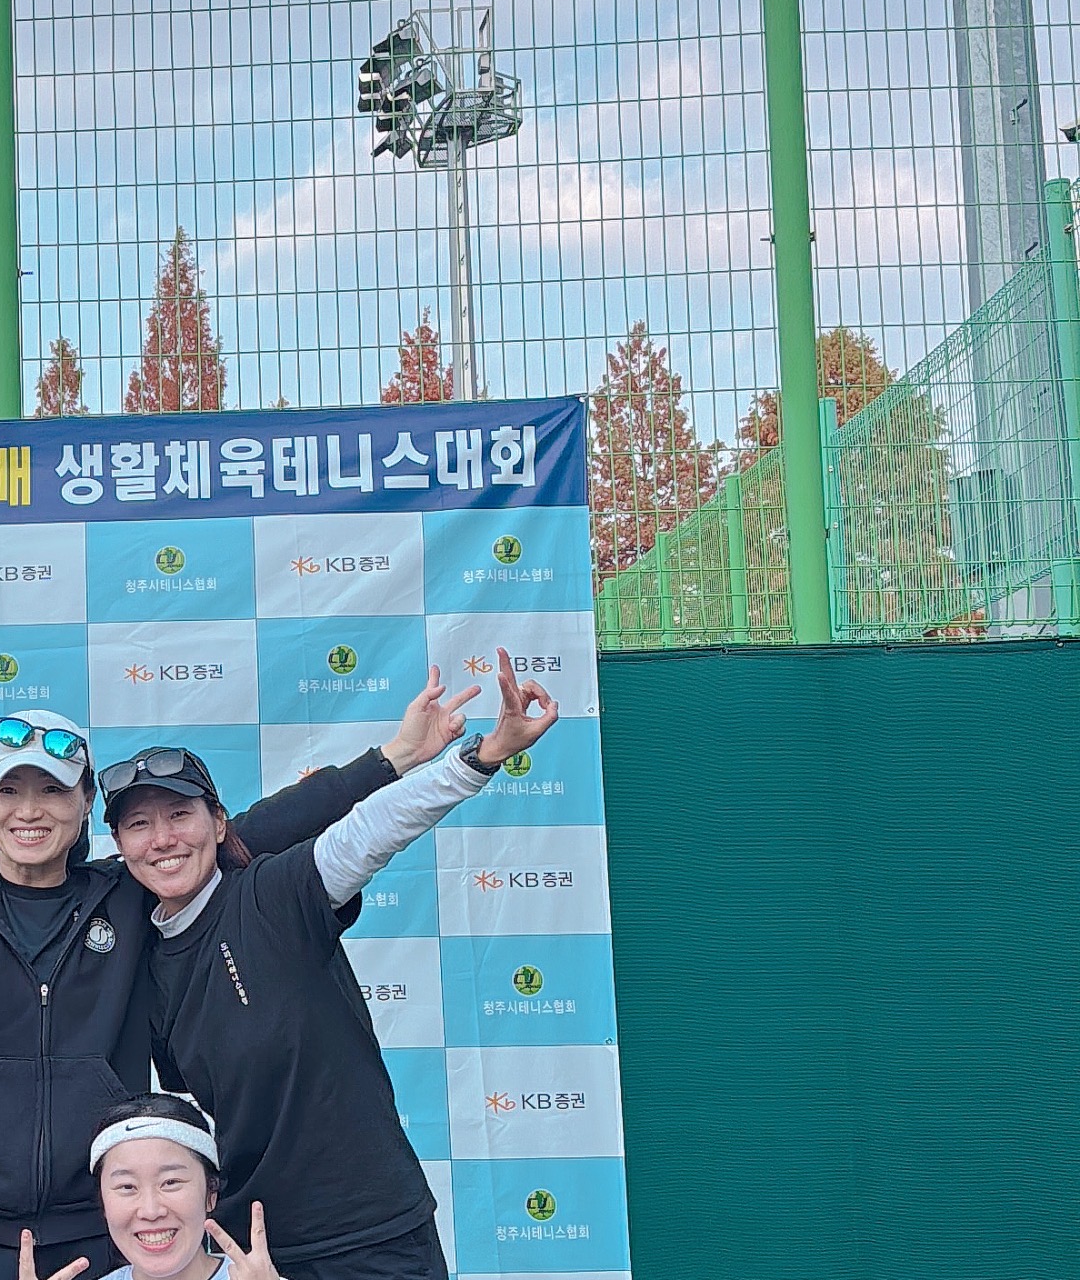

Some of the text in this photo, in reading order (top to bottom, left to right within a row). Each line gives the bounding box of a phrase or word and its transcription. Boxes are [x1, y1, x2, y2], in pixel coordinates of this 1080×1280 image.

[54, 425, 537, 505] 생활체육테니스대회
[327, 556, 389, 572] KB증권
[463, 569, 552, 583] 청주시테니스협회
[126, 578, 216, 593] 청주시테니스협회
[160, 664, 223, 680] KB증권
[508, 656, 561, 672] B증권
[299, 678, 389, 693] 청주시테니스협회
[479, 781, 564, 796] 주시테니스협회
[510, 872, 572, 887] KB증권
[361, 984, 407, 1001] B증권
[484, 1000, 575, 1015] 청주시테니스협회
[522, 1093, 585, 1109] KB증권
[496, 1225, 589, 1241] 청주시테니스협회
